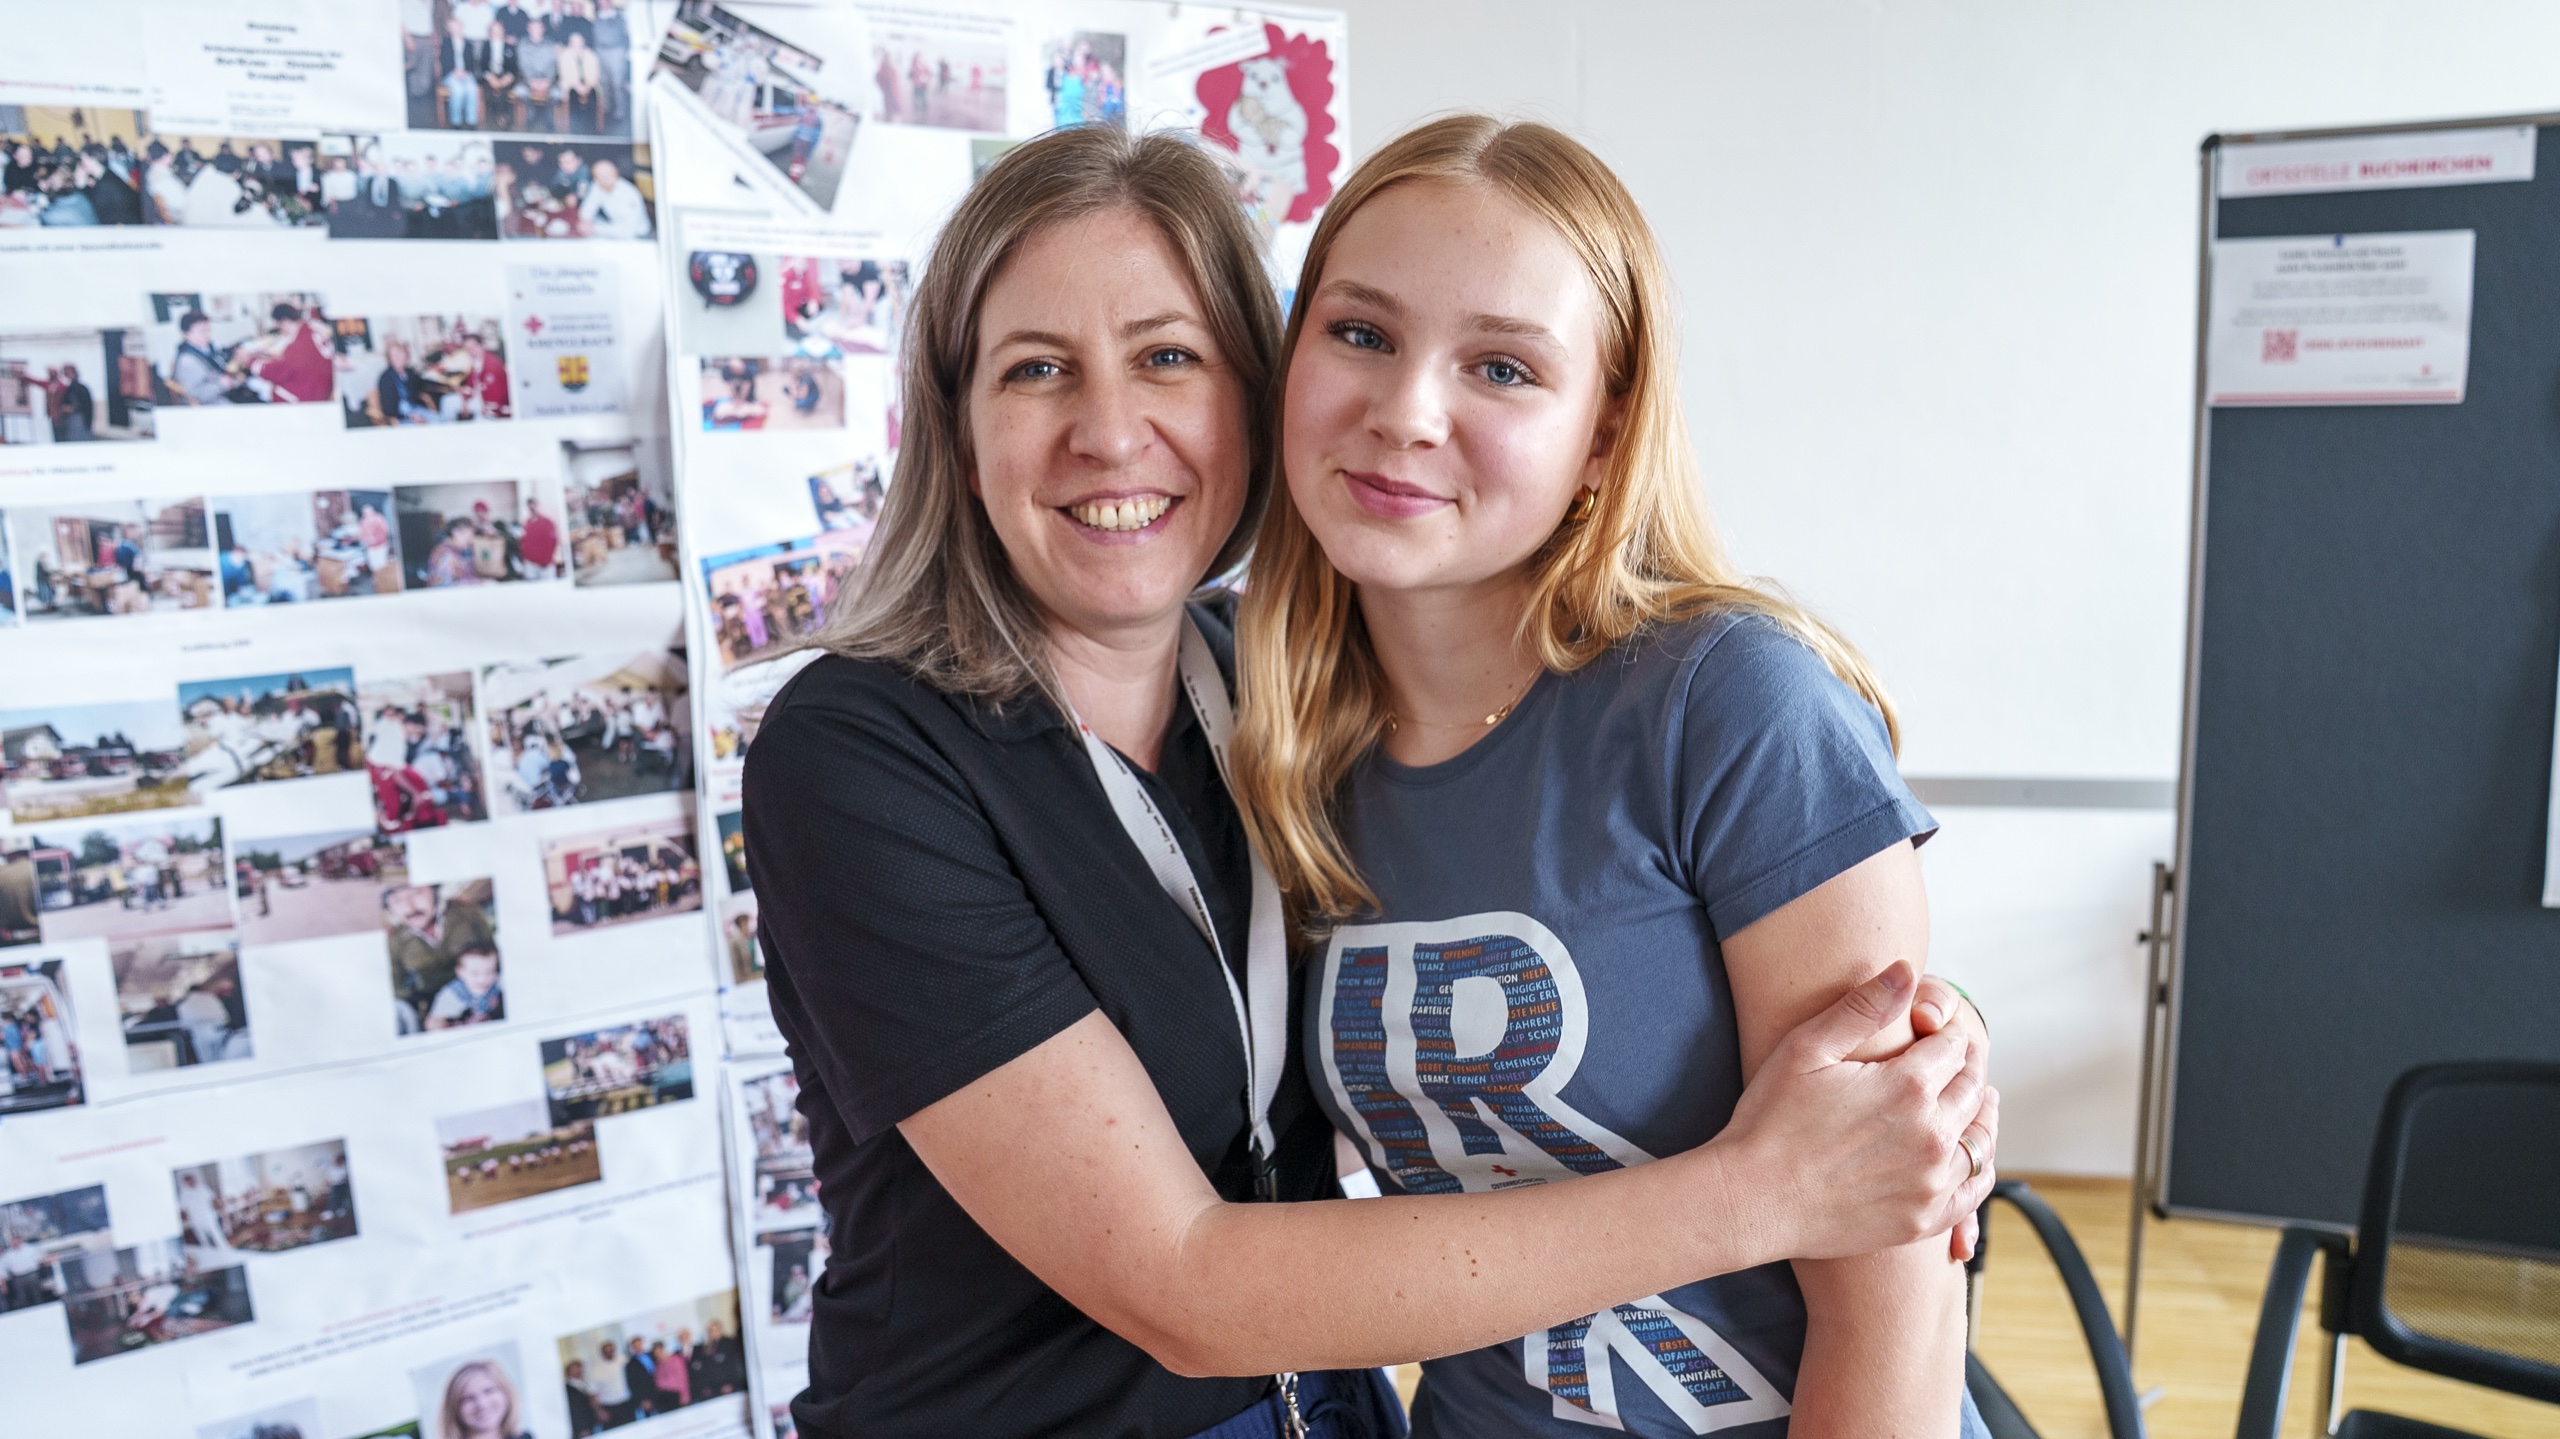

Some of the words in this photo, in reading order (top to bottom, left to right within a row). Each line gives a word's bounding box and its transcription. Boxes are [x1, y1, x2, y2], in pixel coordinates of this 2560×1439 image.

[2246, 161, 2350, 187] ORTSSTELLE
[2358, 153, 2493, 180] BUCHKIRCHEN
[1443, 946, 1483, 959] OFFENHEIT
[1510, 956, 1546, 969] UNIVER
[1529, 1002, 1559, 1015] HILFE
[1339, 1031, 1361, 1040] ERSTE
[1361, 1031, 1384, 1040] HILFE
[1446, 1064, 1490, 1073] OFFENHEIT
[1452, 1076, 1487, 1085] LERNEN
[1490, 1071, 1526, 1082] EINHEIT
[1659, 1340, 1690, 1350] ERSTE
